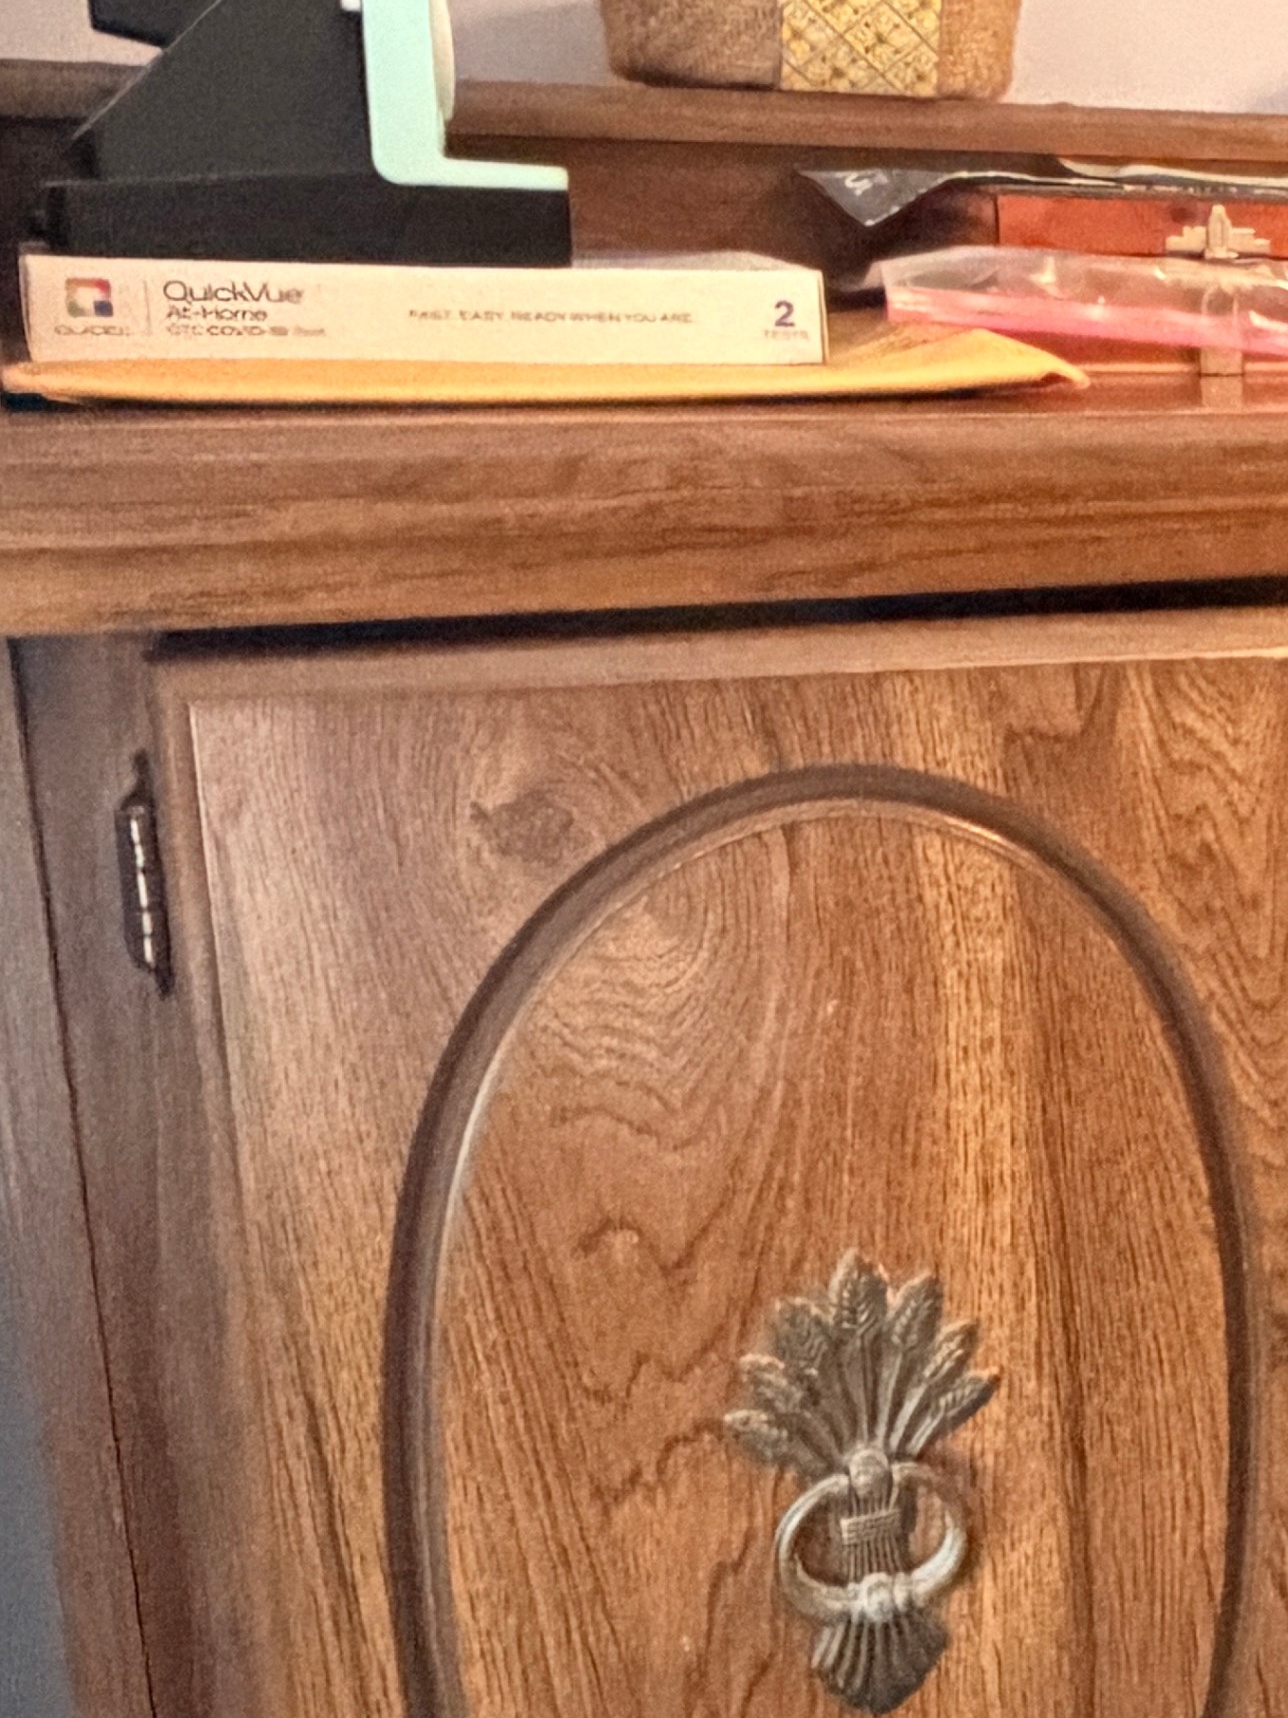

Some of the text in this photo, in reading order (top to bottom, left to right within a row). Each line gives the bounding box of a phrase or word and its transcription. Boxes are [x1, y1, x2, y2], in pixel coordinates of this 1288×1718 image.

[161, 279, 304, 304] QuickVue
[166, 305, 269, 322] At-Home
[774, 300, 796, 327] 2
